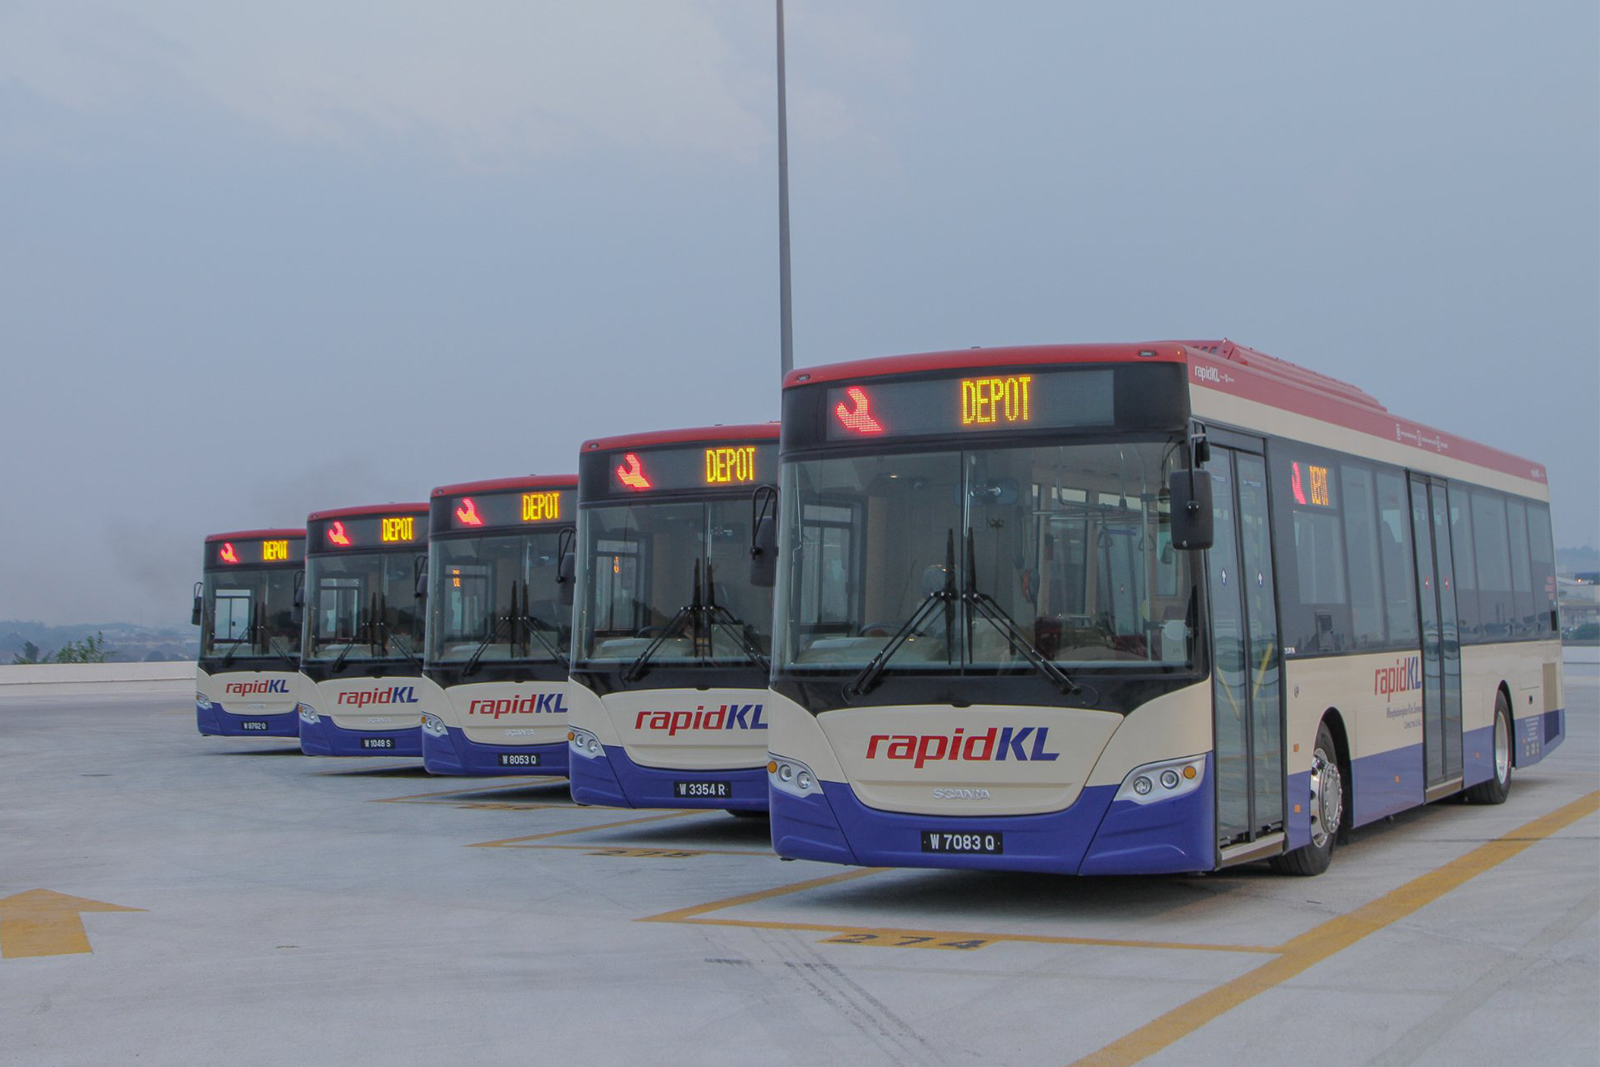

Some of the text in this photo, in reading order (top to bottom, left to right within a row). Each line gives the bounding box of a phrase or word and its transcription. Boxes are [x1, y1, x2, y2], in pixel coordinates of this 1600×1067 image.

[961, 376, 1031, 424] DEPOT
[706, 447, 755, 483] DEPOT
[522, 492, 560, 521] DEPOT
[382, 517, 414, 542] DEPOT
[263, 540, 288, 560] DEPOT
[226, 679, 290, 697] rapidKL
[1374, 656, 1422, 703] rapidKL
[338, 686, 419, 708] rapidKL
[469, 693, 568, 719] rapidKL
[634, 704, 768, 736] rapidKL
[364, 739, 392, 748] W 1048 S
[866, 727, 1060, 769] rapidKL
[502, 755, 537, 765] W 8053 Q
[679, 783, 726, 796] W 3354 R
[932, 788, 991, 800] SCANIA
[930, 834, 995, 851] W 7083 Q
[827, 933, 988, 949] 274
